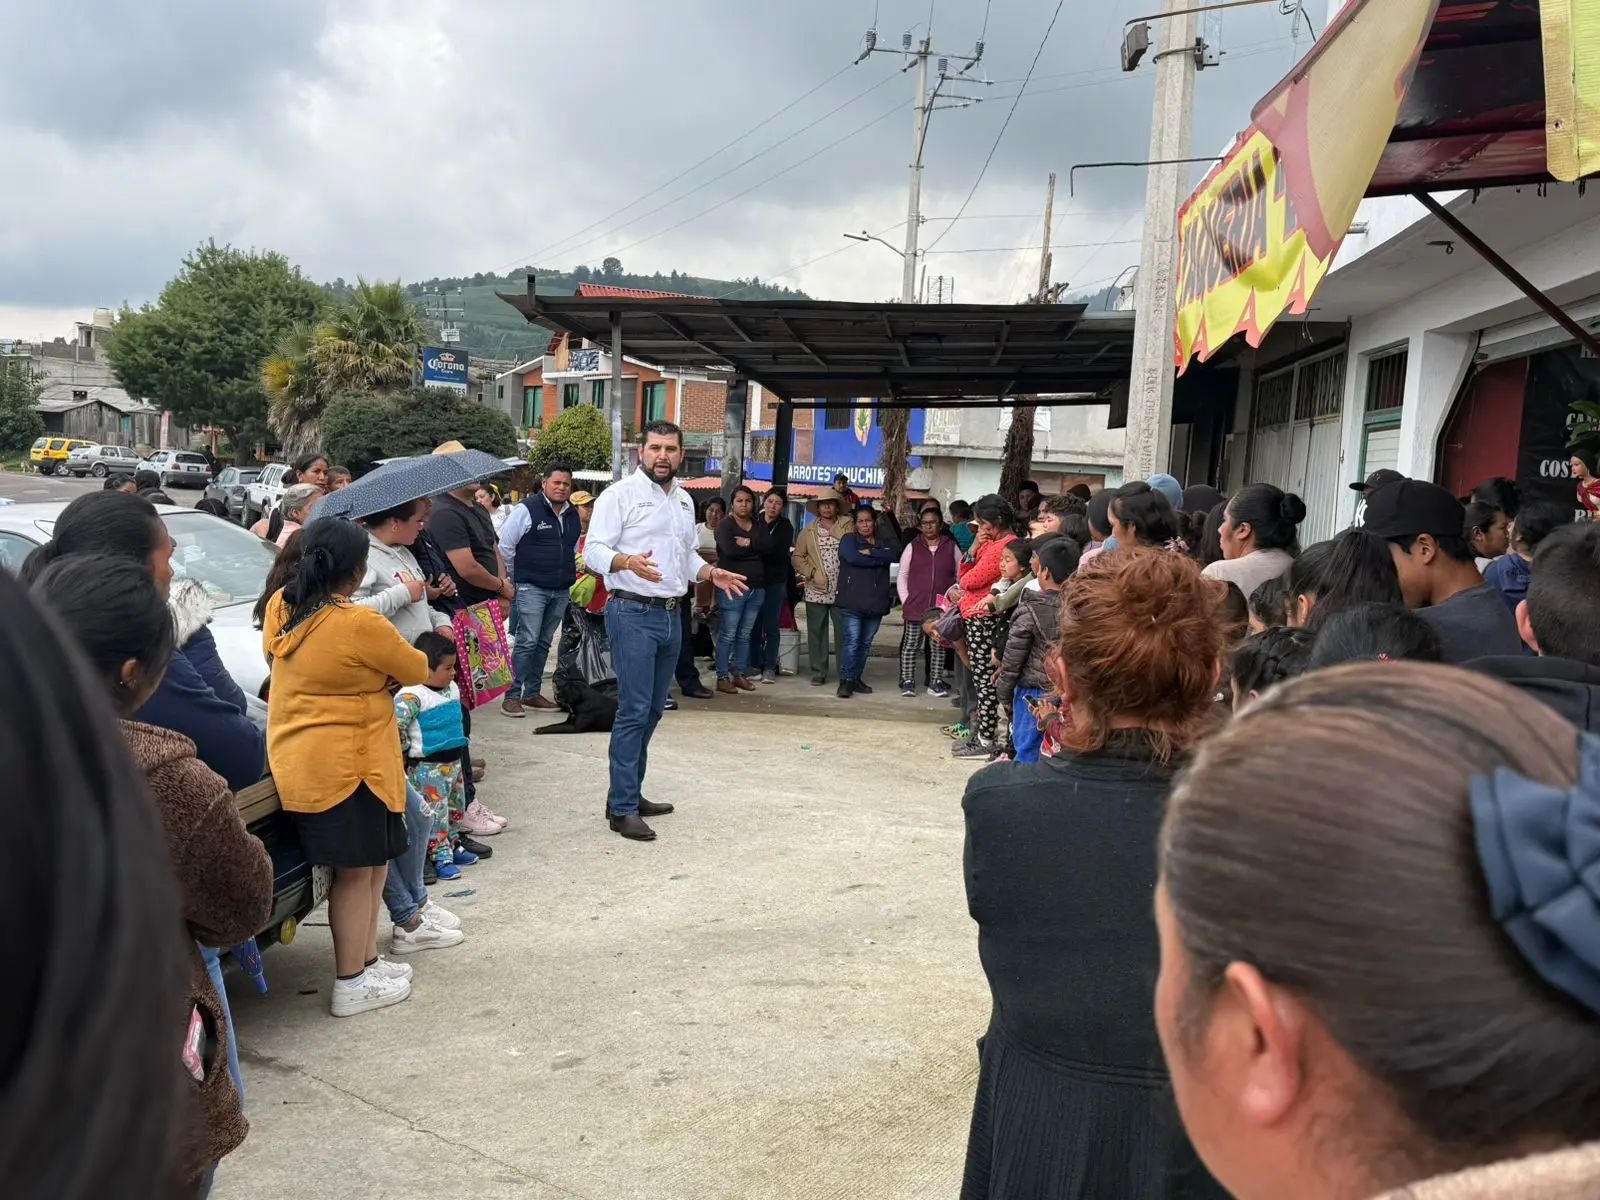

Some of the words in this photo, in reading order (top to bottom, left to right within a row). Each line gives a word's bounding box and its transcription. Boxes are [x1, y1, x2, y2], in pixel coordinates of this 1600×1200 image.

[428, 358, 465, 371] Corona
[788, 466, 831, 482] ARROTES
[1540, 460, 1577, 478] COS
